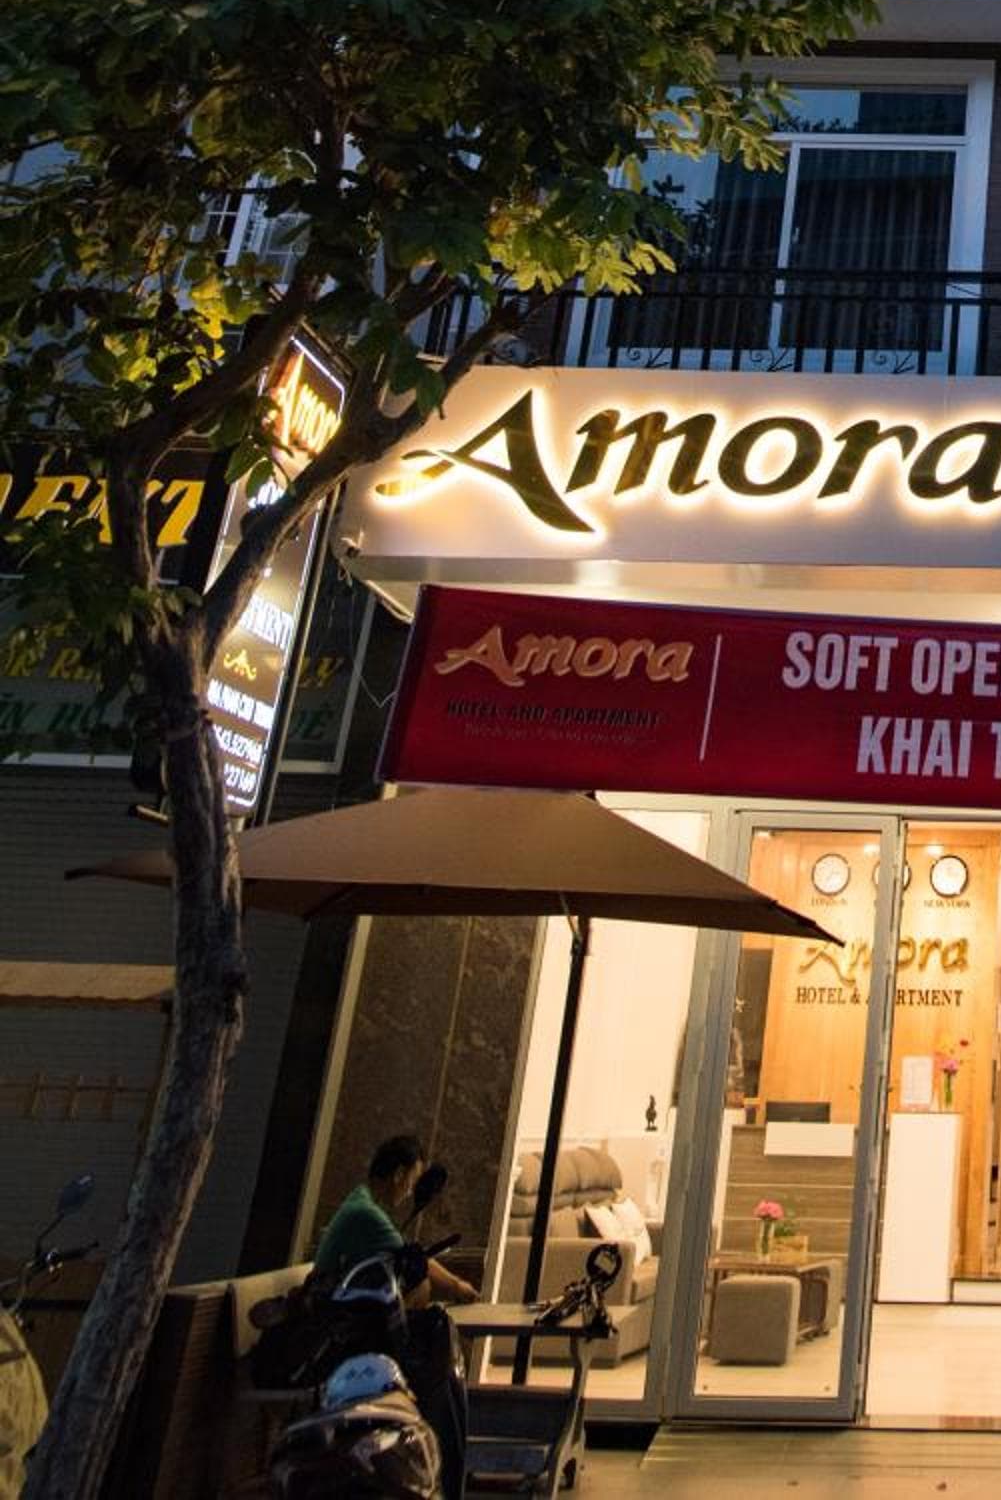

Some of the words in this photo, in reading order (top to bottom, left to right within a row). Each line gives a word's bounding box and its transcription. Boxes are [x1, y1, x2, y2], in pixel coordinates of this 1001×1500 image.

[435, 625, 694, 687] Amora
[782, 631, 899, 692] SOFT
[856, 715, 973, 778] KHAI
[796, 986, 846, 1005] HOTEL
